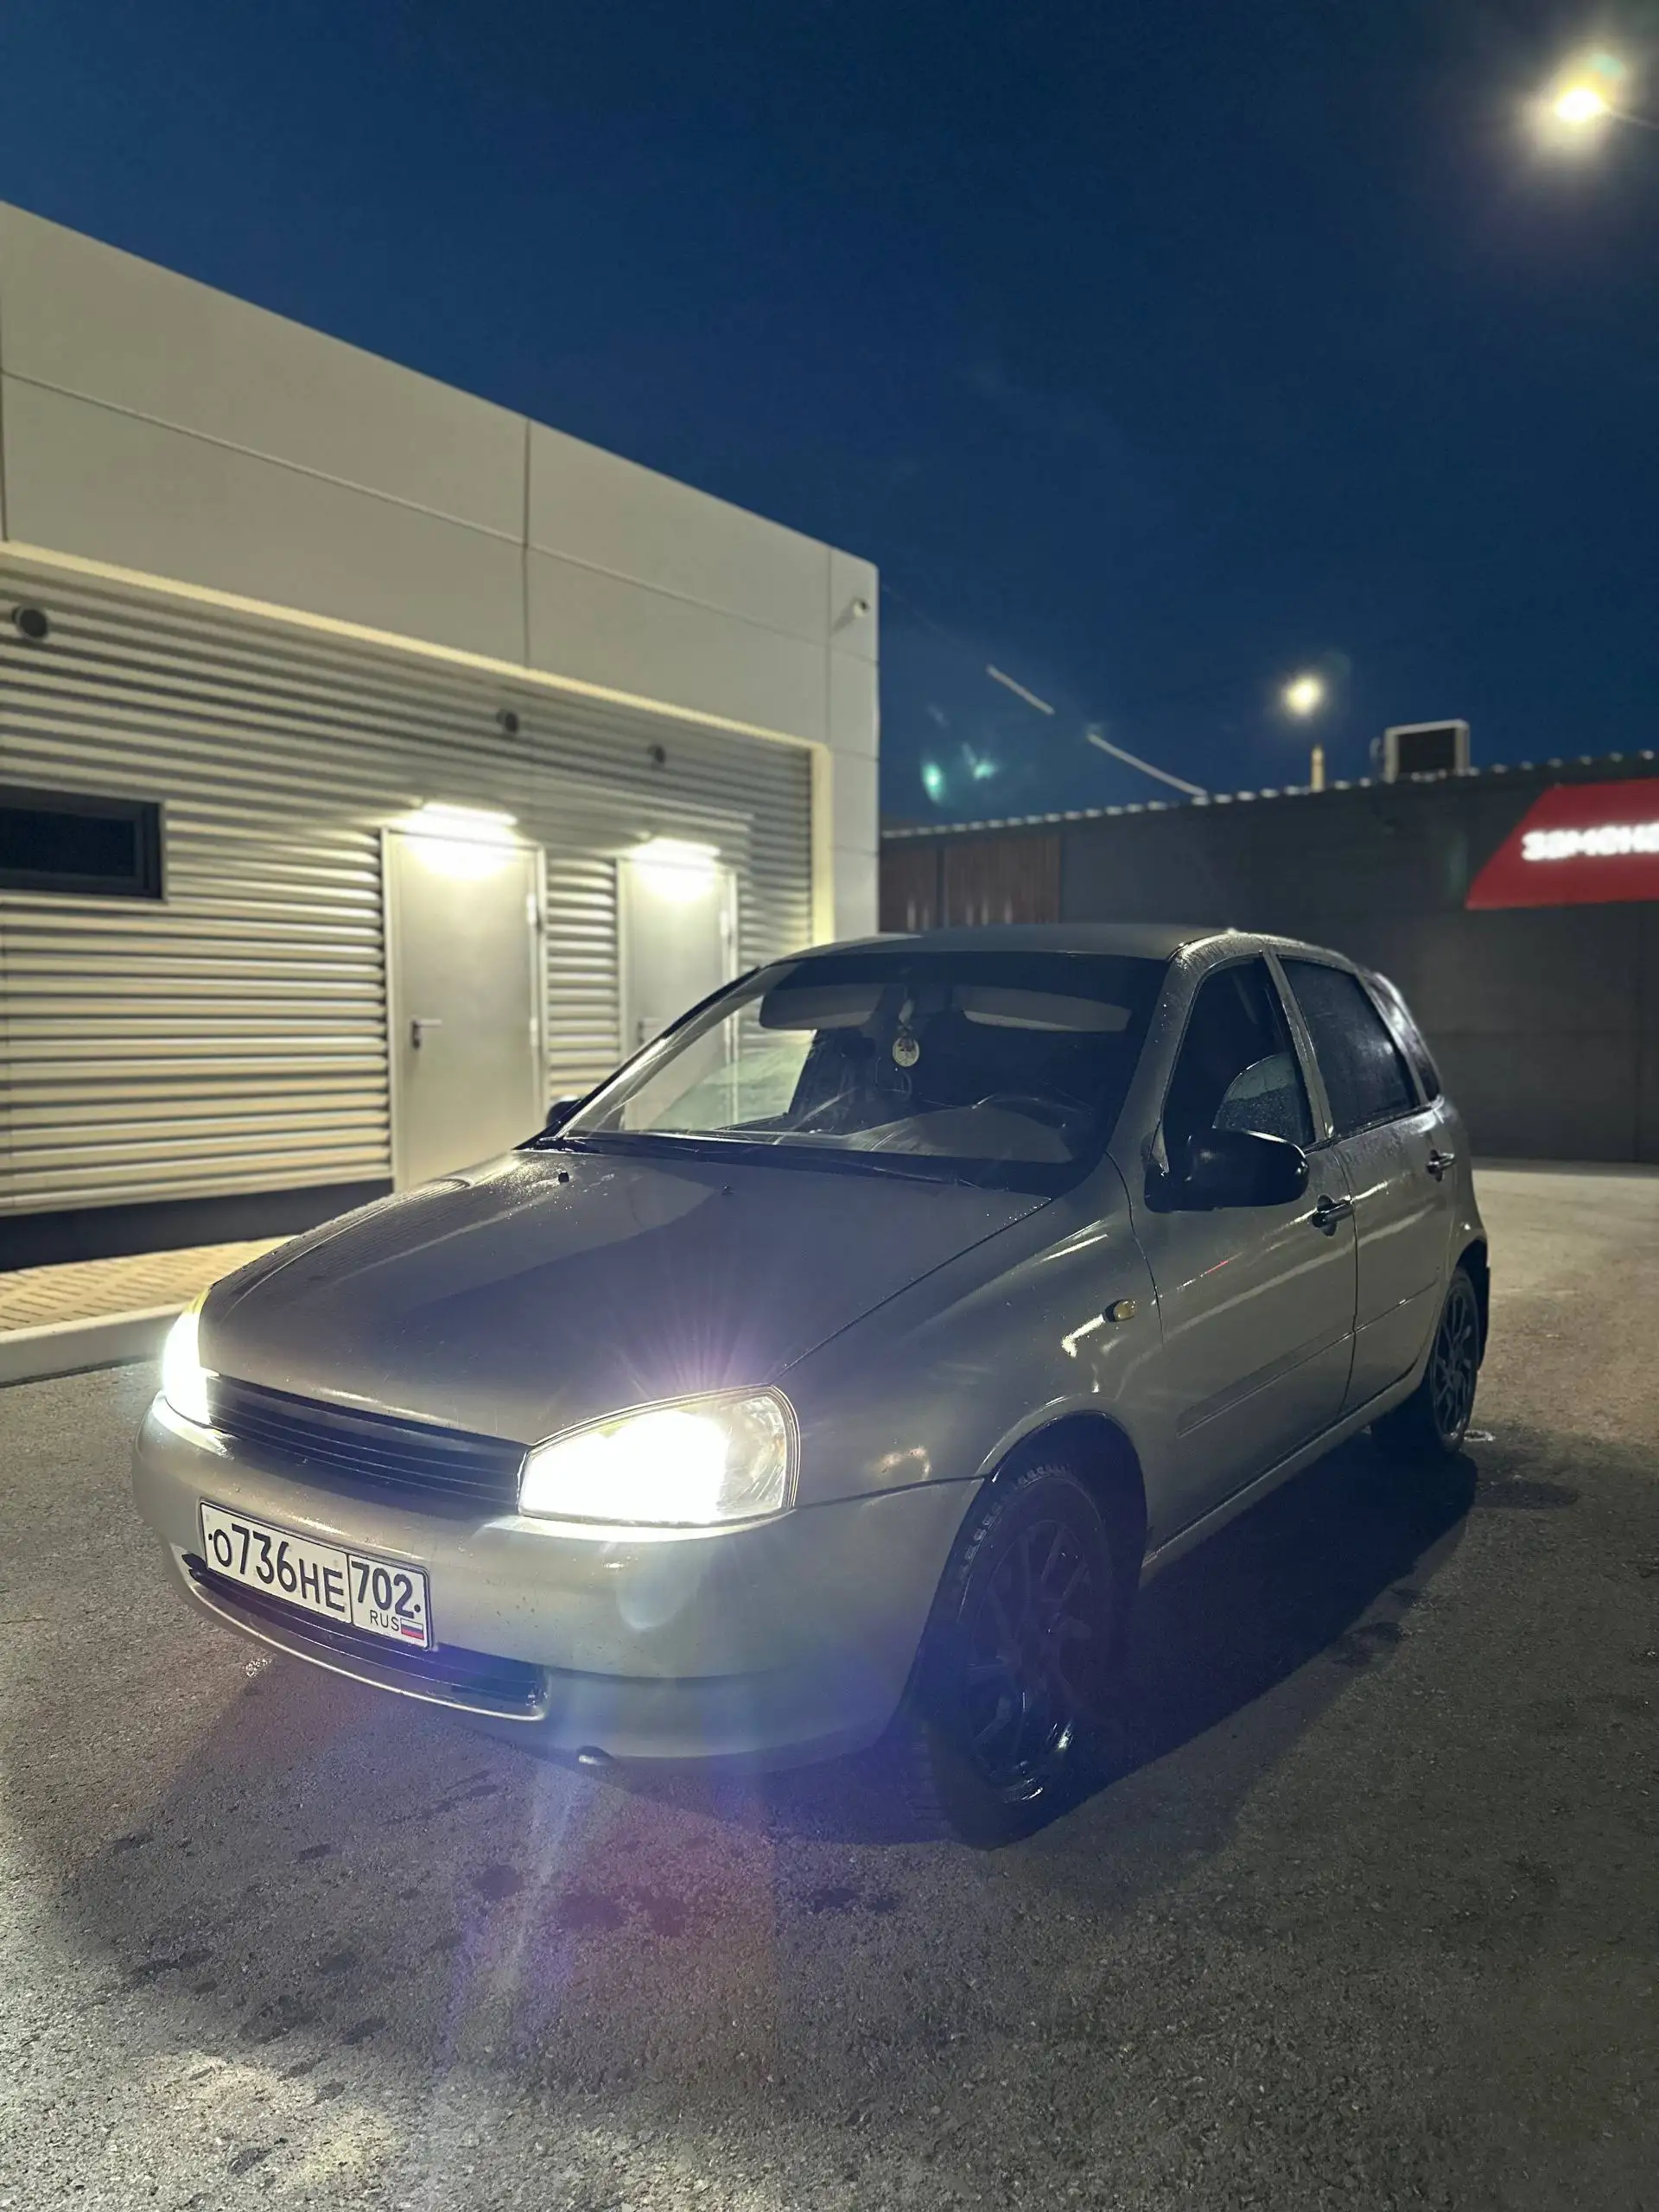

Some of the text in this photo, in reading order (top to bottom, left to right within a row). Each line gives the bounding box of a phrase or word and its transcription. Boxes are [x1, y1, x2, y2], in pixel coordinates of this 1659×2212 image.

[213, 1522, 414, 1618] О736НЕ 702
[370, 1610, 399, 1631] RUS
